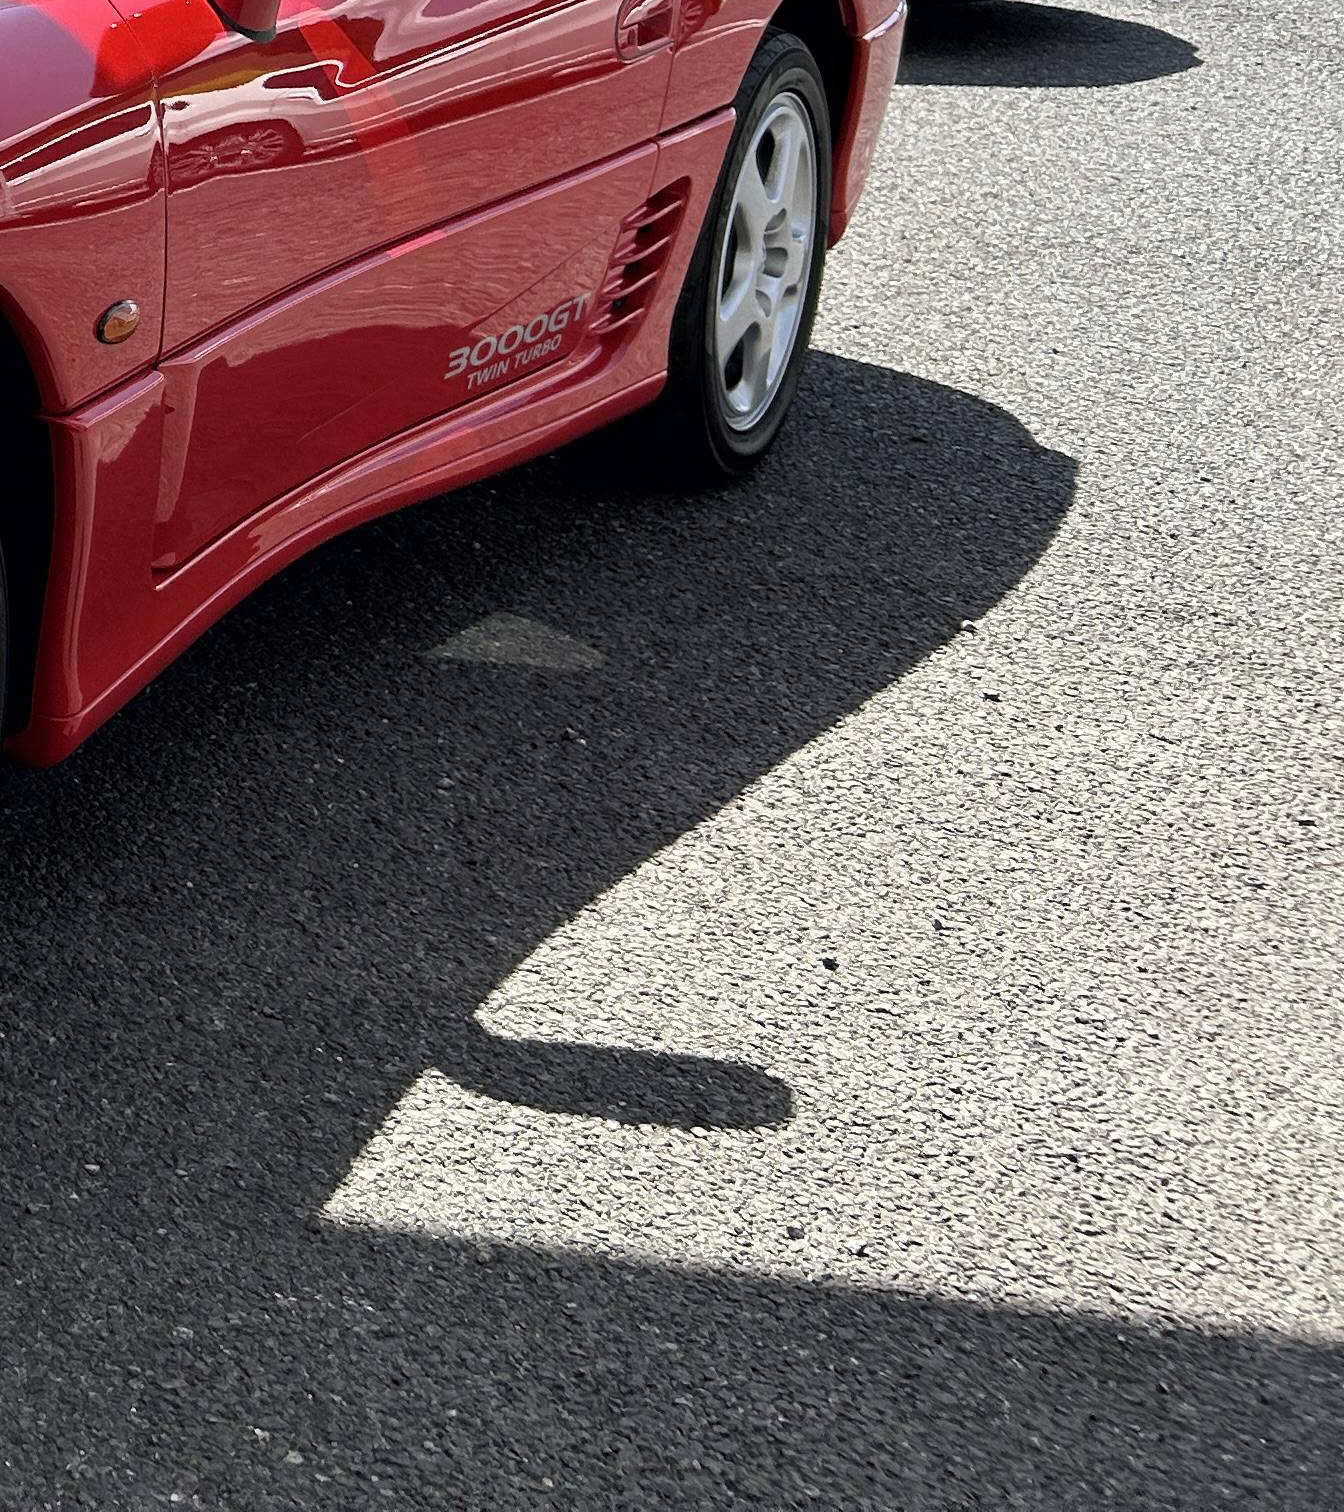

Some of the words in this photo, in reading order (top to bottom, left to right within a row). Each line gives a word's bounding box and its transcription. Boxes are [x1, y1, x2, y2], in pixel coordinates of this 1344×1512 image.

[444, 291, 593, 380] 3000GT
[467, 360, 509, 392] TWIN
[514, 335, 562, 370] TURBO
